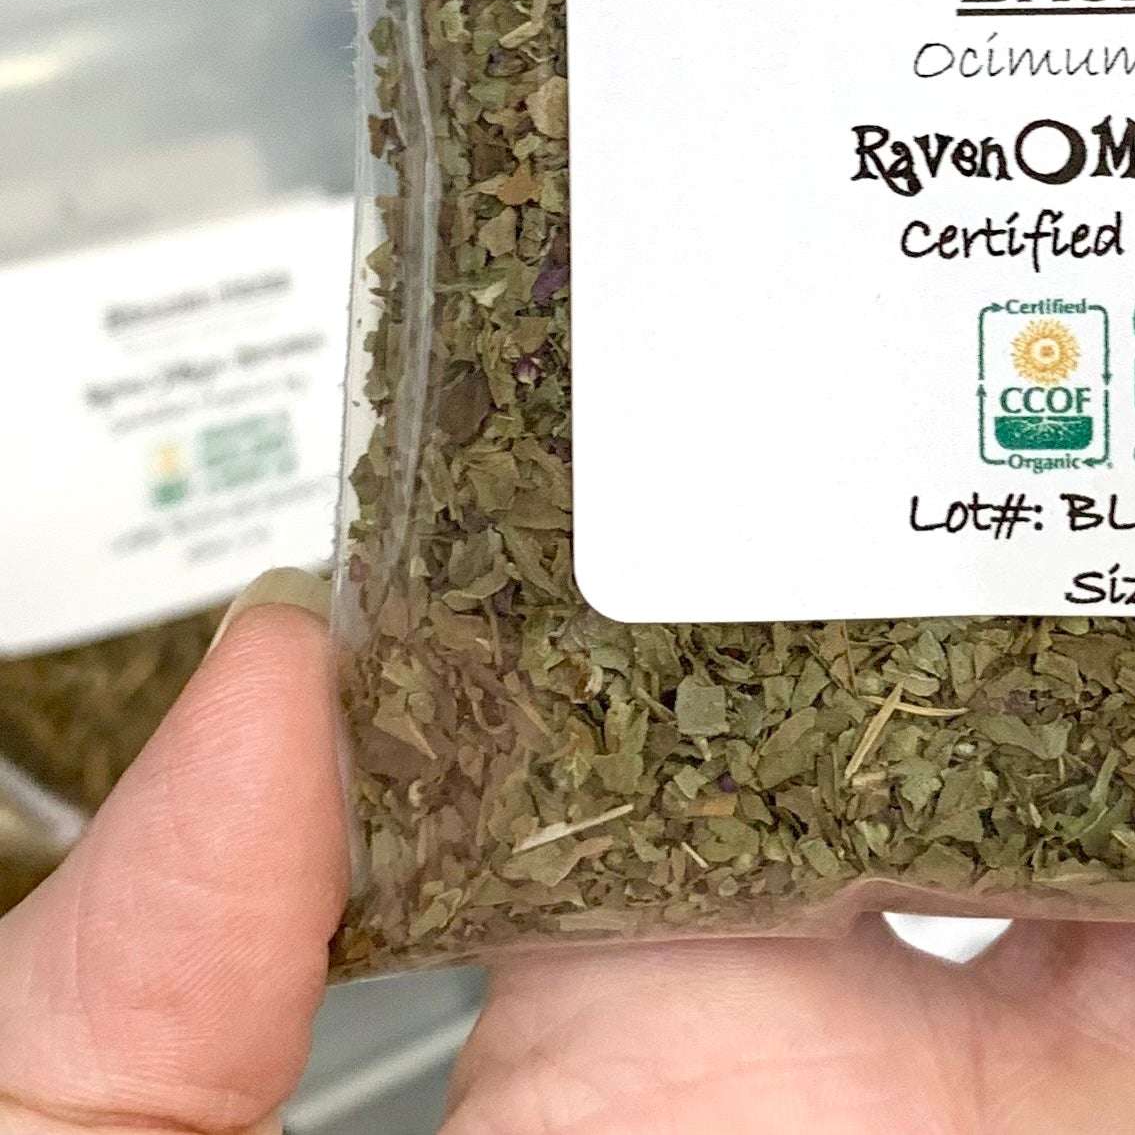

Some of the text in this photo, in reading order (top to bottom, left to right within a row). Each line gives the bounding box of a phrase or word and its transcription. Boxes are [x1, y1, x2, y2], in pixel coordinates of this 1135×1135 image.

[900, 208, 1125, 274] Certified
[1004, 298, 1088, 316] Certified
[999, 386, 1092, 415] CCOF
[1007, 452, 1081, 474] Organic
[909, 491, 1044, 541] Lot#:
